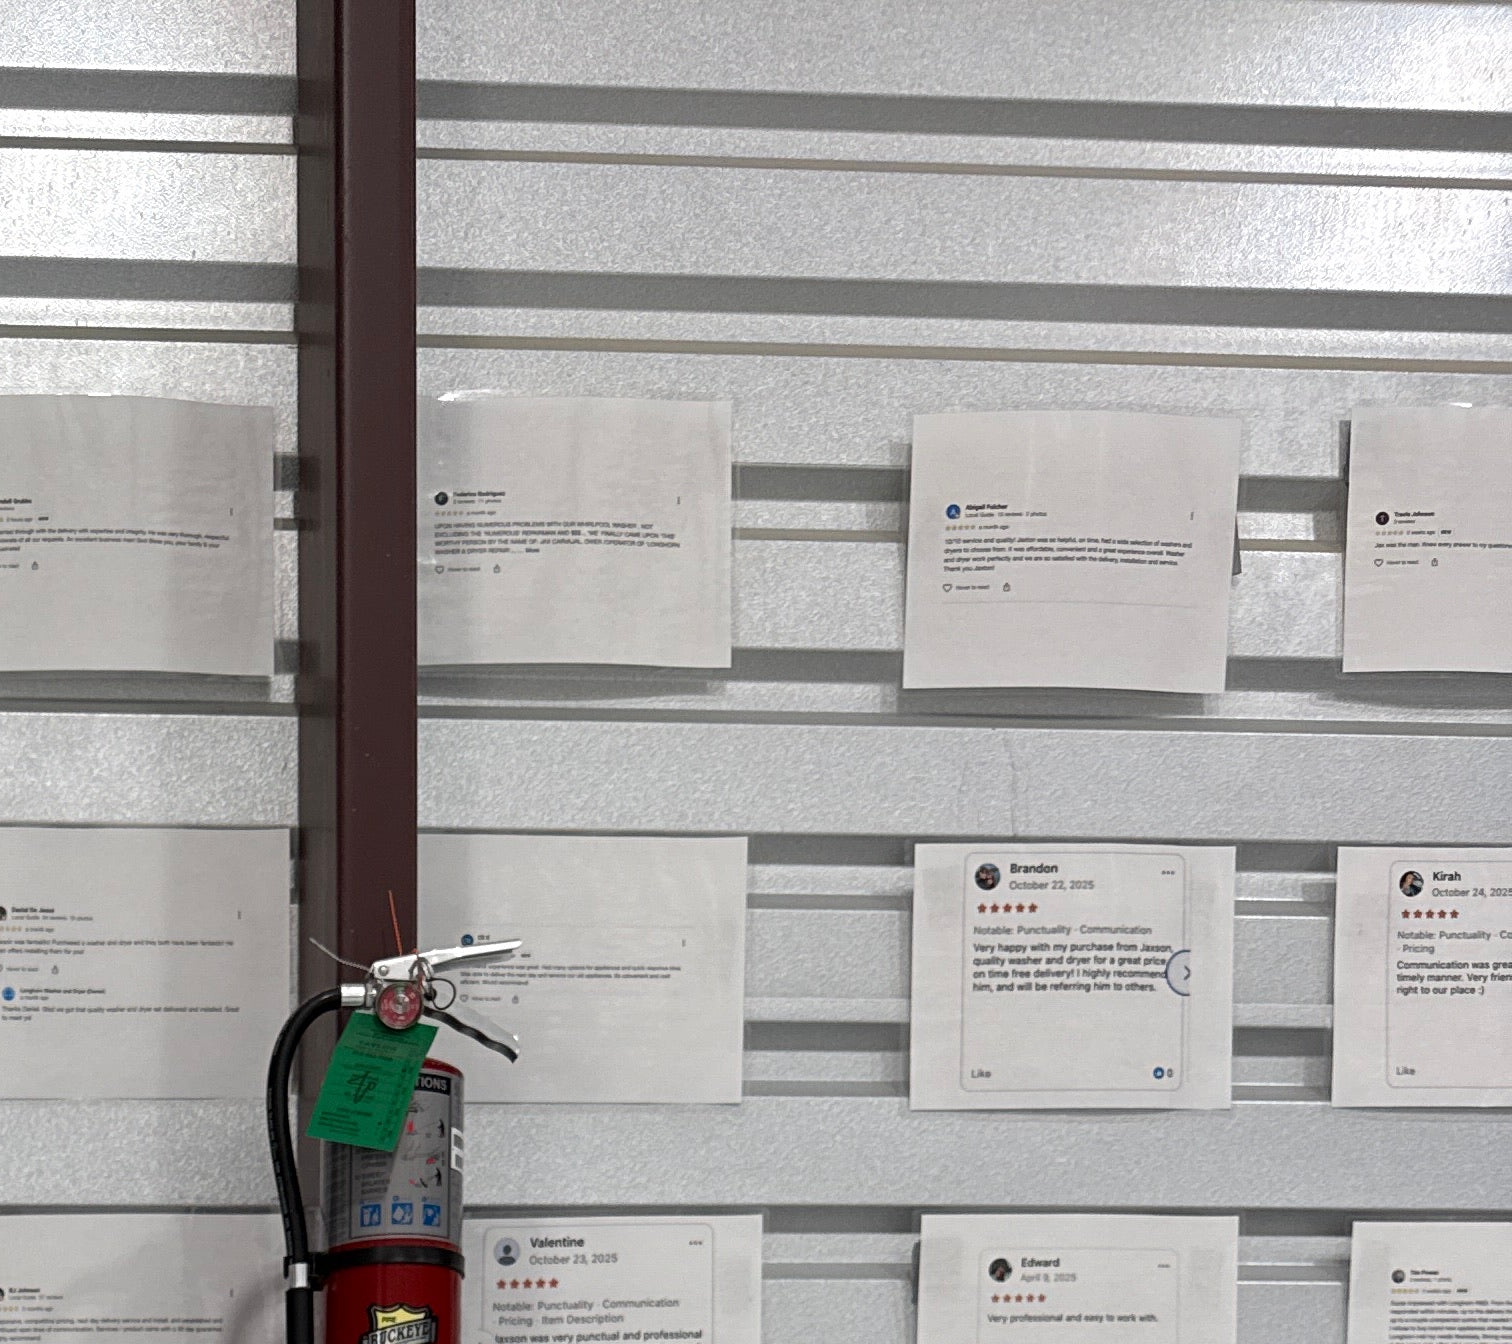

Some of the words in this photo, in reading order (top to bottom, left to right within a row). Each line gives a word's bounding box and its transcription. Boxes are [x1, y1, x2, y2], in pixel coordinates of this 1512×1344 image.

[1009, 862, 1058, 875] Brandon
[1432, 870, 1461, 882] Kirah
[529, 1235, 584, 1249] Valentine
